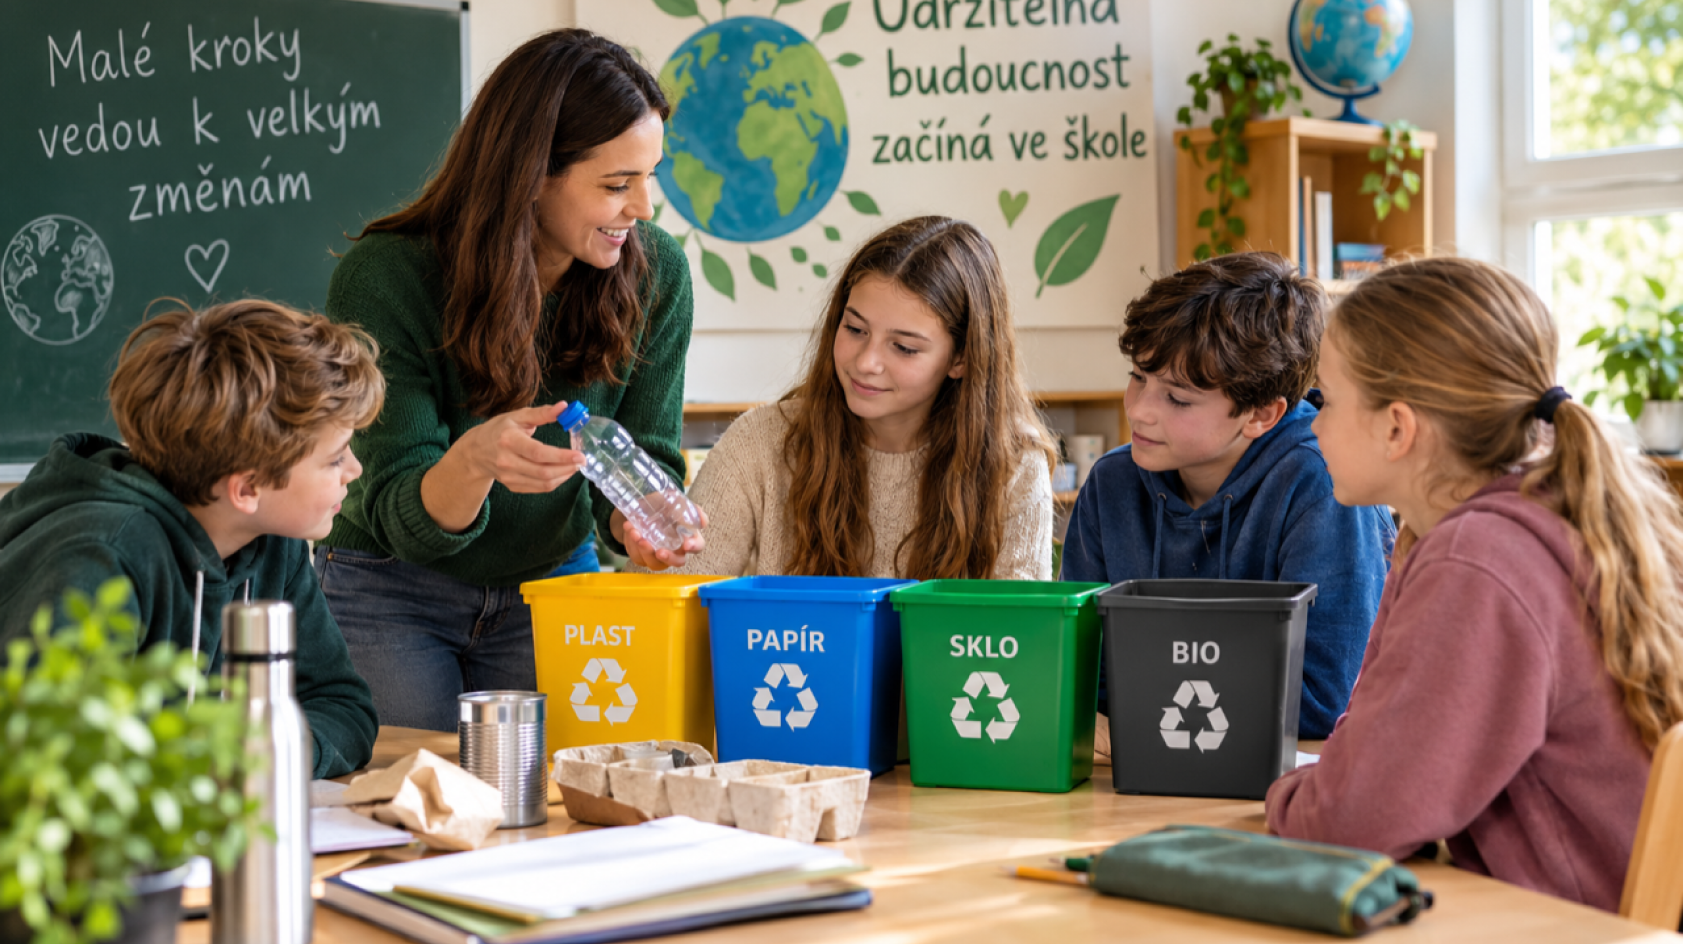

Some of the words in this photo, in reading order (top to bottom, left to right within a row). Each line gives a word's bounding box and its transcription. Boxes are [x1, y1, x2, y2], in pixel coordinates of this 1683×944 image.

[48, 21, 155, 87] Malé
[188, 16, 301, 81] kroky
[887, 42, 1130, 97] budoucnost
[39, 102, 161, 158] vedou
[193, 97, 219, 144] k
[247, 82, 381, 153] velkým
[872, 113, 994, 164] začíná
[1009, 131, 1048, 161] ve
[1063, 112, 1148, 161] škole
[129, 155, 311, 221] změnám
[564, 624, 635, 647] PLAST
[747, 625, 825, 653] PAPÍR
[950, 634, 1019, 659] SKLO
[1172, 641, 1220, 665] BIO
